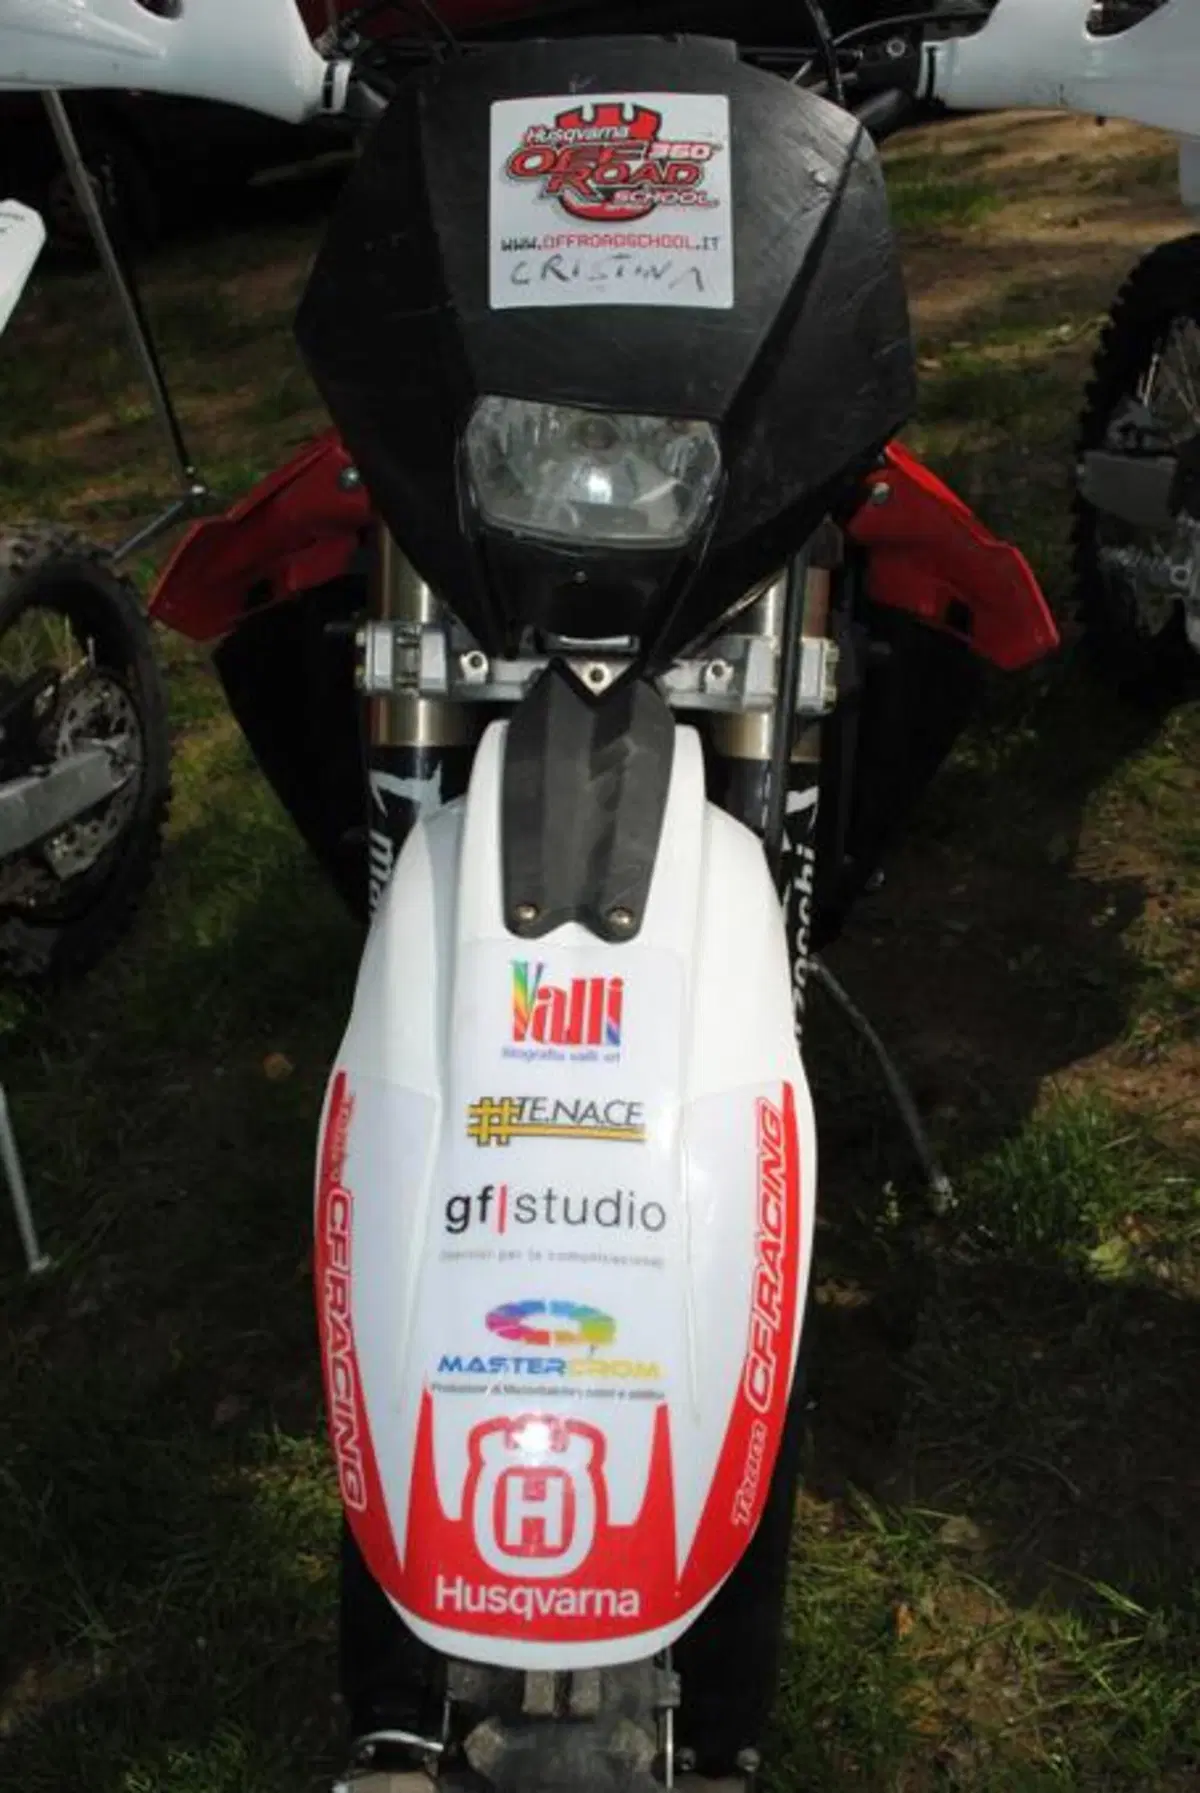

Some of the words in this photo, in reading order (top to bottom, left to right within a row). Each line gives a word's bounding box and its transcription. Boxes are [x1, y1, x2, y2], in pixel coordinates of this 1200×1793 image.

[527, 126, 630, 147] Husqvarna
[546, 162, 702, 200] ROAD
[610, 189, 720, 207] SCHOOL
[512, 961, 625, 1046] Valli
[434, 1574, 640, 1621] Husqvarna
